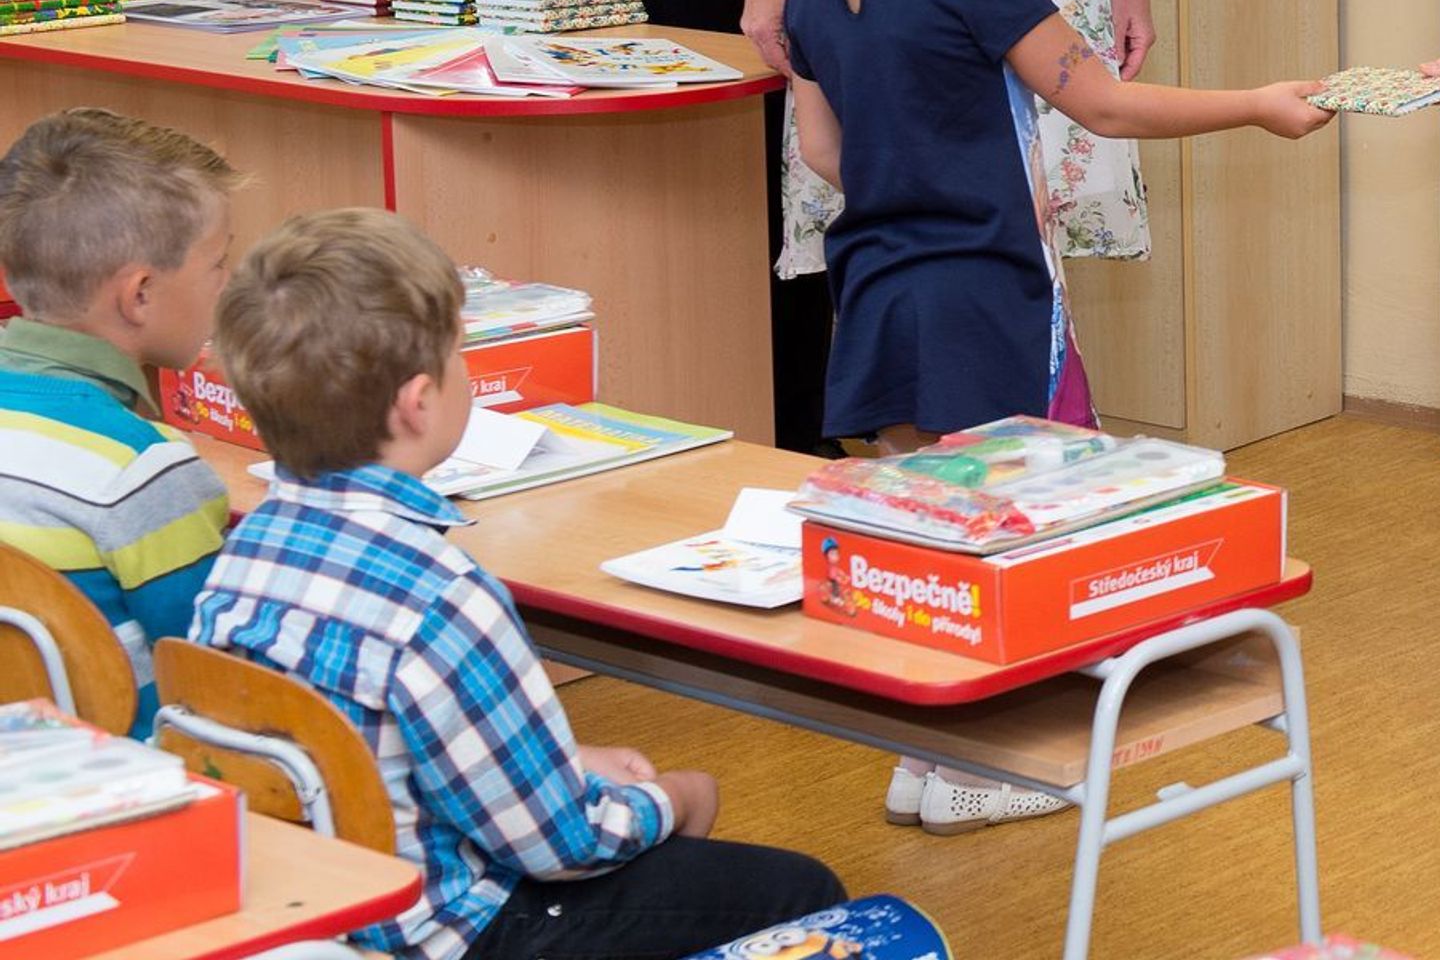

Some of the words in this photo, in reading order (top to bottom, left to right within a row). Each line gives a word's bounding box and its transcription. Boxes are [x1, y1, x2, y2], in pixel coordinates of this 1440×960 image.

[850, 554, 982, 619] Bezpečně!
[1088, 559, 1172, 598] Středočeský
[1173, 550, 1199, 573] kraj
[44, 871, 91, 907] kraj
